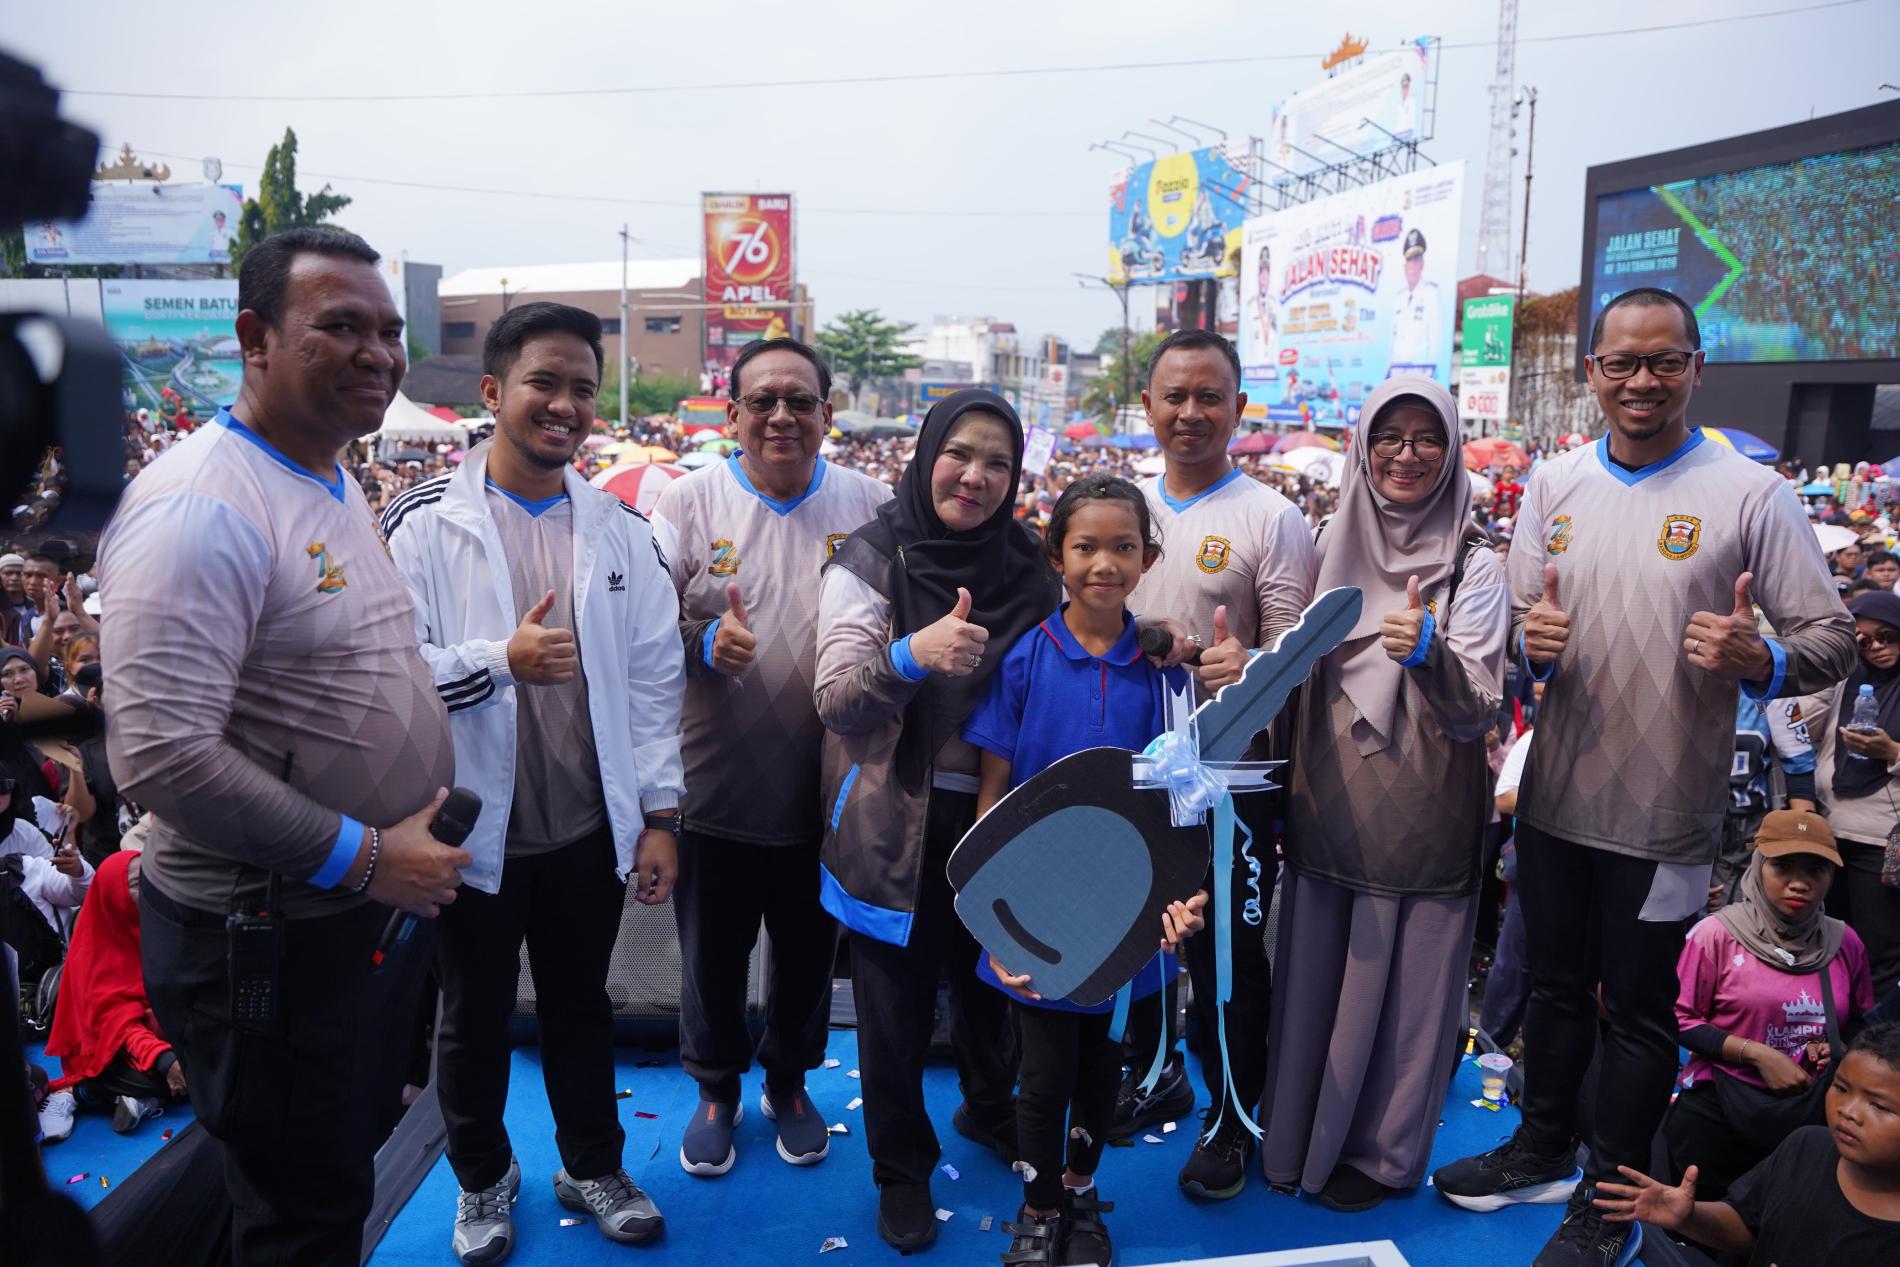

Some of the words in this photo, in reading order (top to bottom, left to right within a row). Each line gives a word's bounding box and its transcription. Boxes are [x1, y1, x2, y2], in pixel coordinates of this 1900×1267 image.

[725, 220, 769, 275] 76
[1606, 232, 1643, 253] JALAN
[1644, 228, 1680, 249] SEHAT
[1281, 251, 1326, 296] JALAN
[1329, 248, 1380, 284] SEHAT
[144, 298, 194, 310] SEMEN
[200, 298, 237, 310] BATU
[722, 285, 776, 302] APEL
